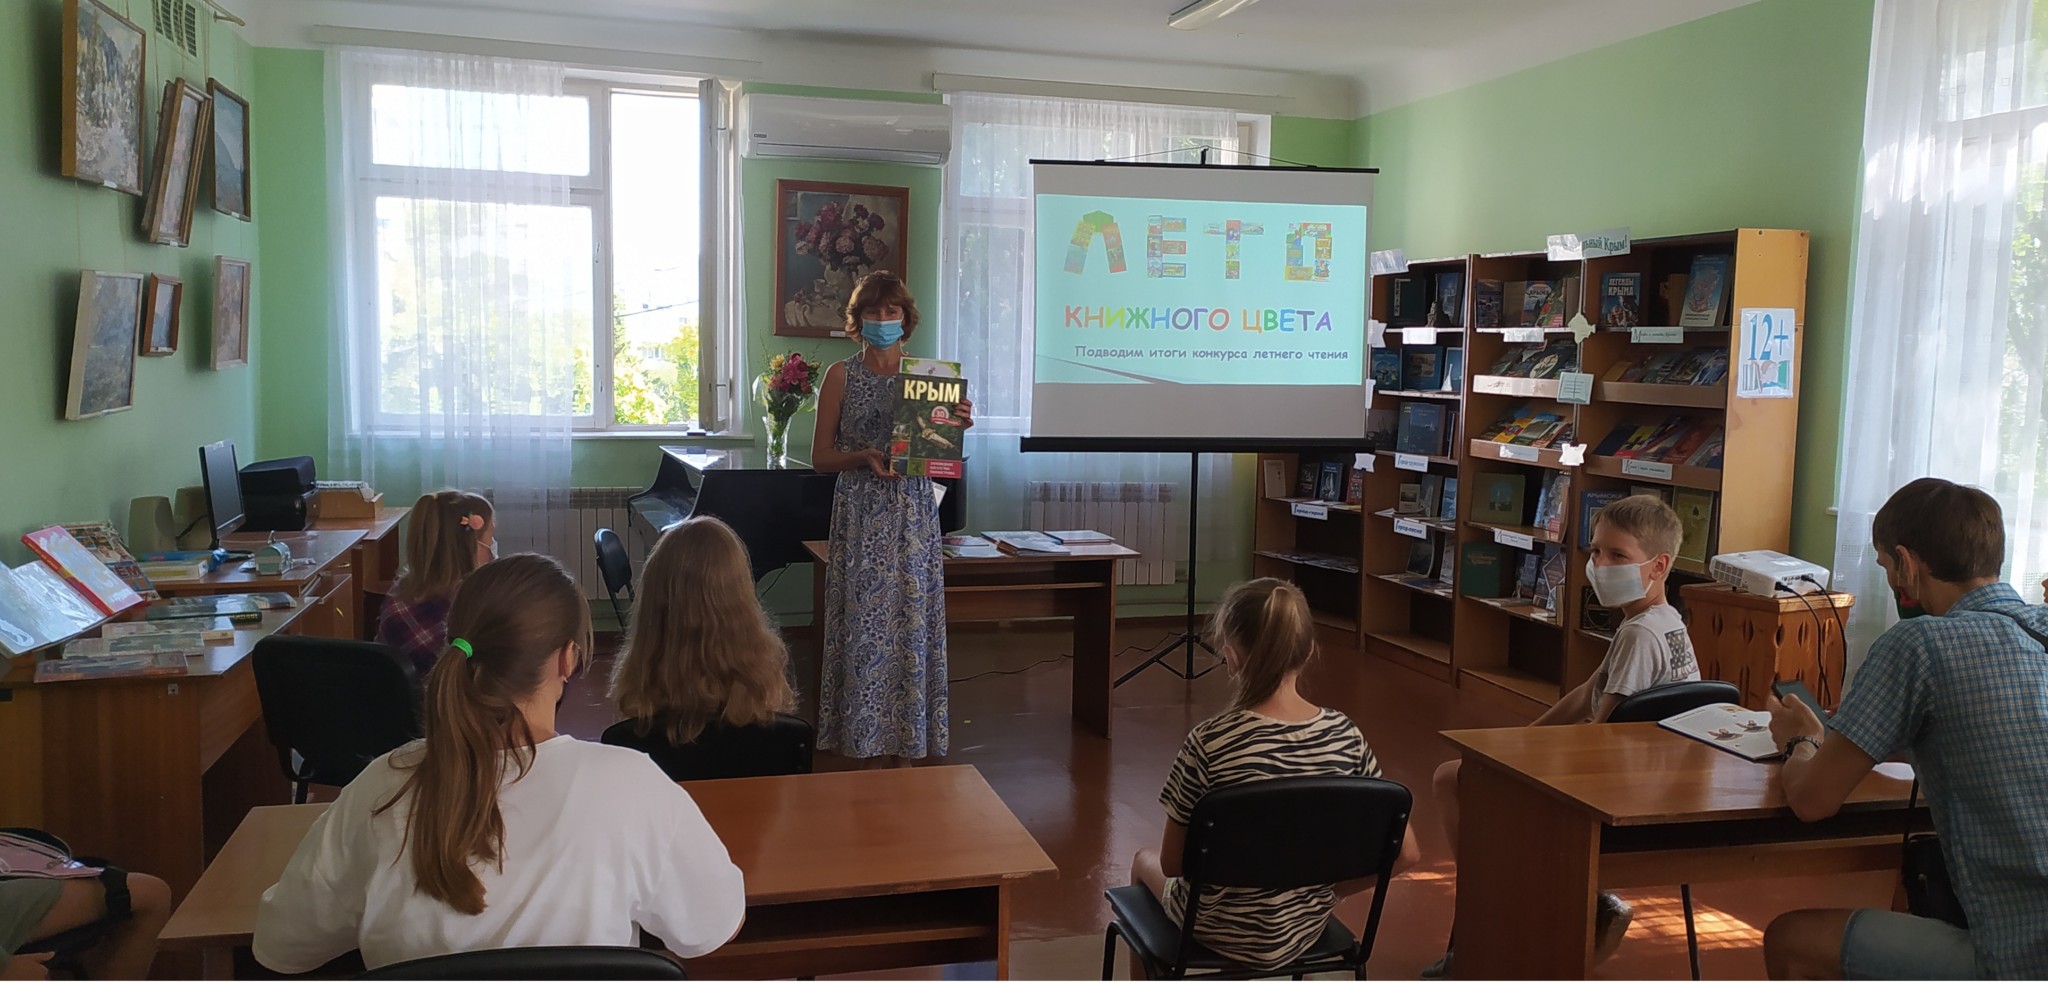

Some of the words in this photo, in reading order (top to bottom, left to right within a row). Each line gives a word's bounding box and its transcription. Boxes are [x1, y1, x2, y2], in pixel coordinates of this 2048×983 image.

[1064, 210, 1333, 282] ЛЕТО
[1608, 278, 1634, 286] ЛЕГЕНДЫ
[1608, 286, 1634, 296] КРЫМА
[1064, 305, 1230, 331] КНИЖНОГО
[1242, 309, 1332, 334] ЦВЕТА
[1747, 313, 1789, 361] 12+
[1074, 345, 1144, 359] Подводим
[1149, 349, 1187, 358] итоги
[1192, 349, 1248, 361] конкурса
[1253, 350, 1303, 360] летнего
[1308, 350, 1349, 360] чтения
[903, 379, 960, 404] КРЫМ
